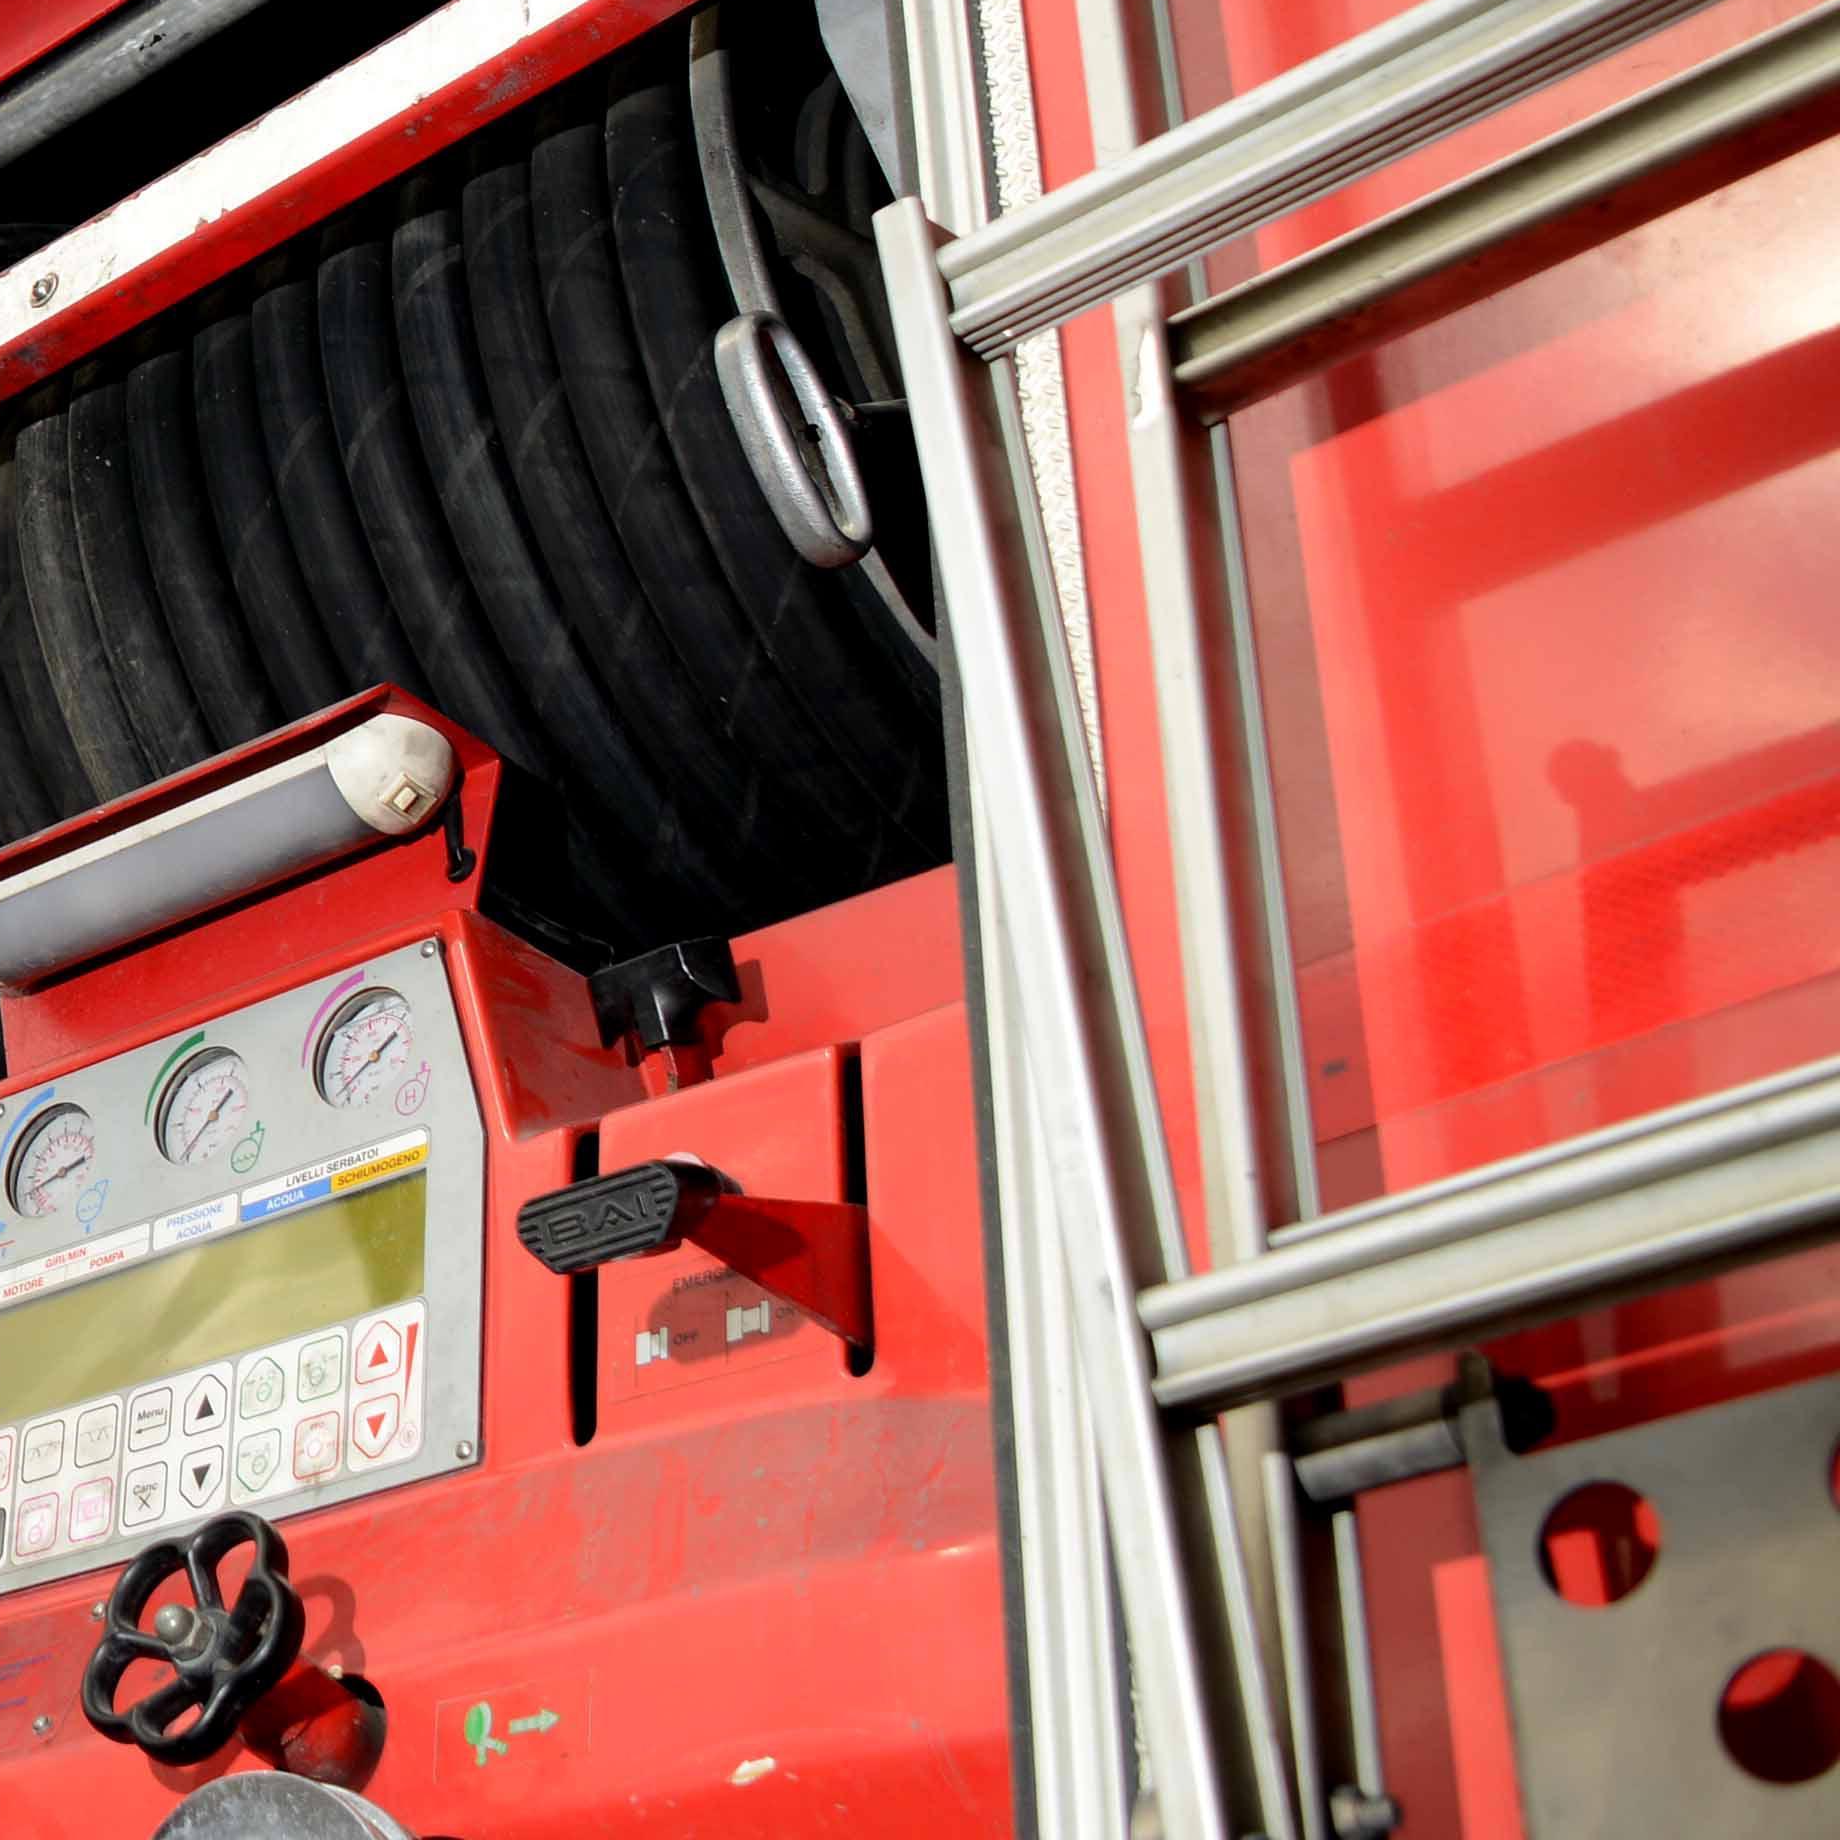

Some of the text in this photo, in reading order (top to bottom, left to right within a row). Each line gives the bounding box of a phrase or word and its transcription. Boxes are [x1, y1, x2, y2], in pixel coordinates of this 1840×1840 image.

[284, 1147, 379, 1188] LIVELLI SERBATOI
[337, 1150, 420, 1187] SCHIUMOGENO
[266, 1190, 304, 1210] ACQUA
[166, 1201, 224, 1229] PRESSIONE
[546, 1189, 652, 1245] BAI
[176, 1222, 212, 1240] ACQUA
[88, 1250, 125, 1270] POMPA
[2, 1276, 45, 1298] MOTORE
[137, 1408, 164, 1421] Menu
[132, 1482, 159, 1497] Canc
